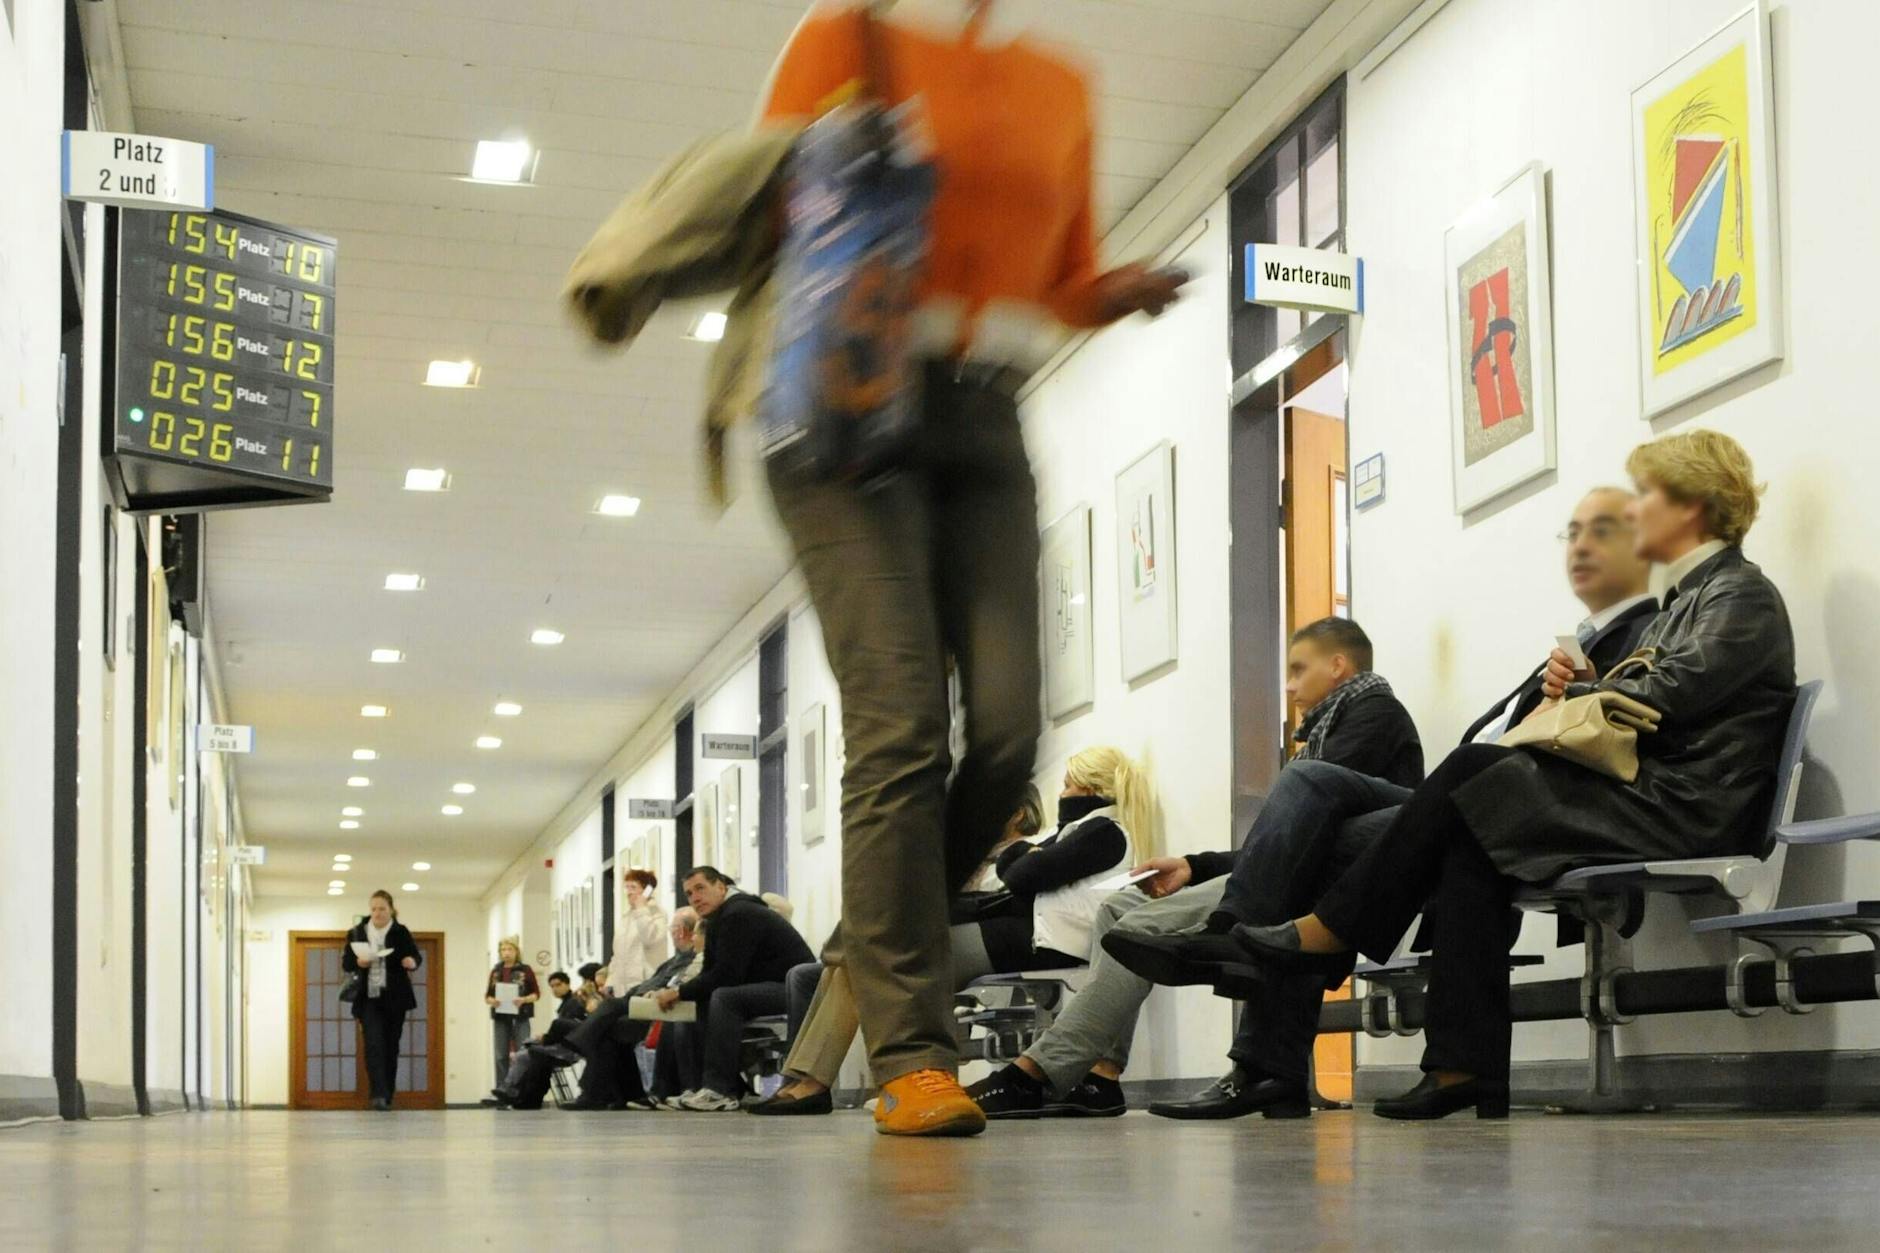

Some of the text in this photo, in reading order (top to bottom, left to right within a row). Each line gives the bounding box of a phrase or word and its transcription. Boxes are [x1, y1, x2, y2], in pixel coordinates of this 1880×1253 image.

[99, 169, 111, 191] 2
[120, 173, 156, 195] und
[114, 138, 164, 164] Platz
[168, 213, 322, 283] 154 Platz 10
[1264, 261, 1351, 291] Warteraum
[167, 264, 322, 331] 155 Platz 7
[166, 314, 322, 380] 156 Platz 12
[150, 360, 321, 428] 025 Platz 7
[150, 411, 320, 477] 026 Platz 11
[708, 740, 750, 752] Warteraum
